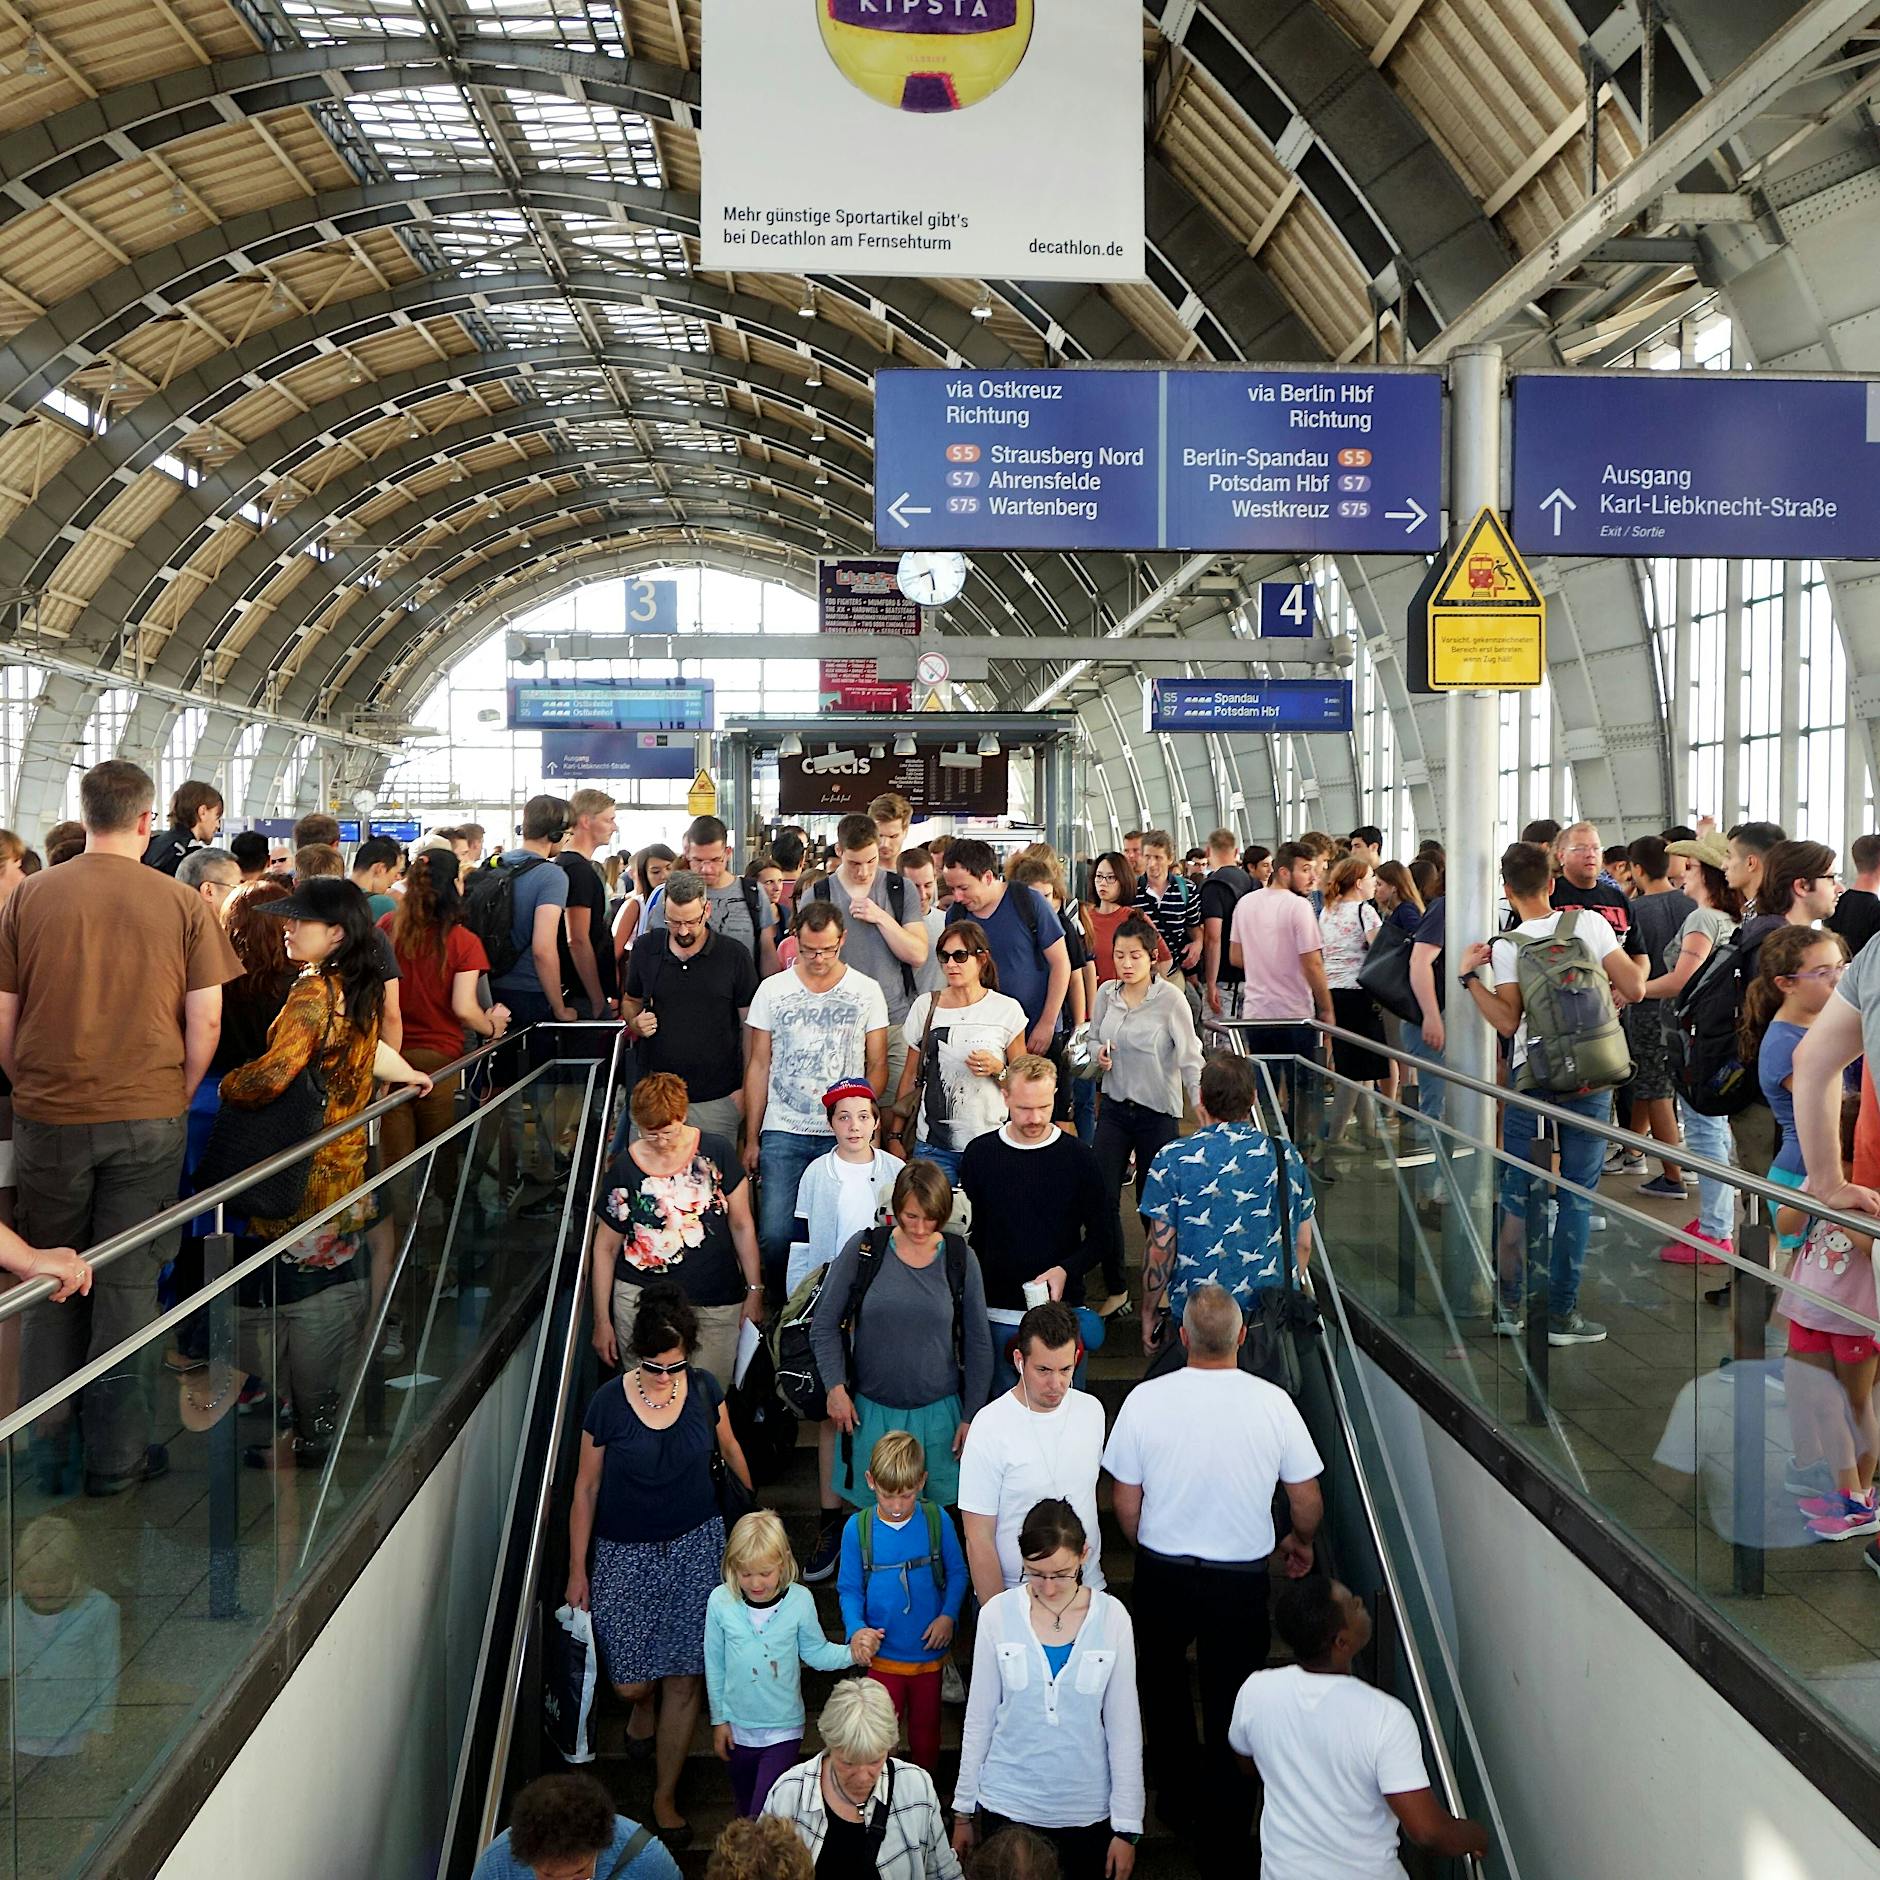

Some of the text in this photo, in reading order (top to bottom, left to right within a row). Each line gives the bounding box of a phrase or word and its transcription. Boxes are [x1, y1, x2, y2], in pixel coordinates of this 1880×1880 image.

[859, 0, 988, 17] KIPSTA
[723, 206, 969, 230] Mehr günstige Sportartikel gibt's
[723, 229, 952, 250] bei Decathlon am Fernsehturm
[1029, 238, 1123, 256] decathlon.de
[946, 380, 1063, 401] via Ostkreuz
[1248, 384, 1375, 404] via Berlin Hbf
[946, 404, 1030, 428] Richtung
[1289, 409, 1373, 433] Richtung
[950, 445, 1145, 469] S5 Strausberg Nord
[1183, 448, 1367, 470] Berlin-Spandau S5
[952, 471, 1102, 492] S7 Ahrensfelde
[1208, 474, 1366, 493] Potsdam Hbf S7
[1601, 464, 1692, 489] Ausgang
[948, 497, 1098, 520] S75 Wartenberg
[1232, 498, 1369, 518] Westkreuz S75
[1600, 494, 1838, 518] Karl-Liebknecht-Straße
[1600, 524, 1666, 538] Exit / Sortie
[630, 580, 656, 622] 3
[1279, 584, 1308, 625] 4
[1163, 692, 1178, 703] S5
[1214, 692, 1260, 704] Spandau
[1163, 706, 1178, 716] S7
[1214, 706, 1260, 717] Potsdam
[1262, 706, 1280, 716] Hbf
[782, 1007, 858, 1026] GARAGE
